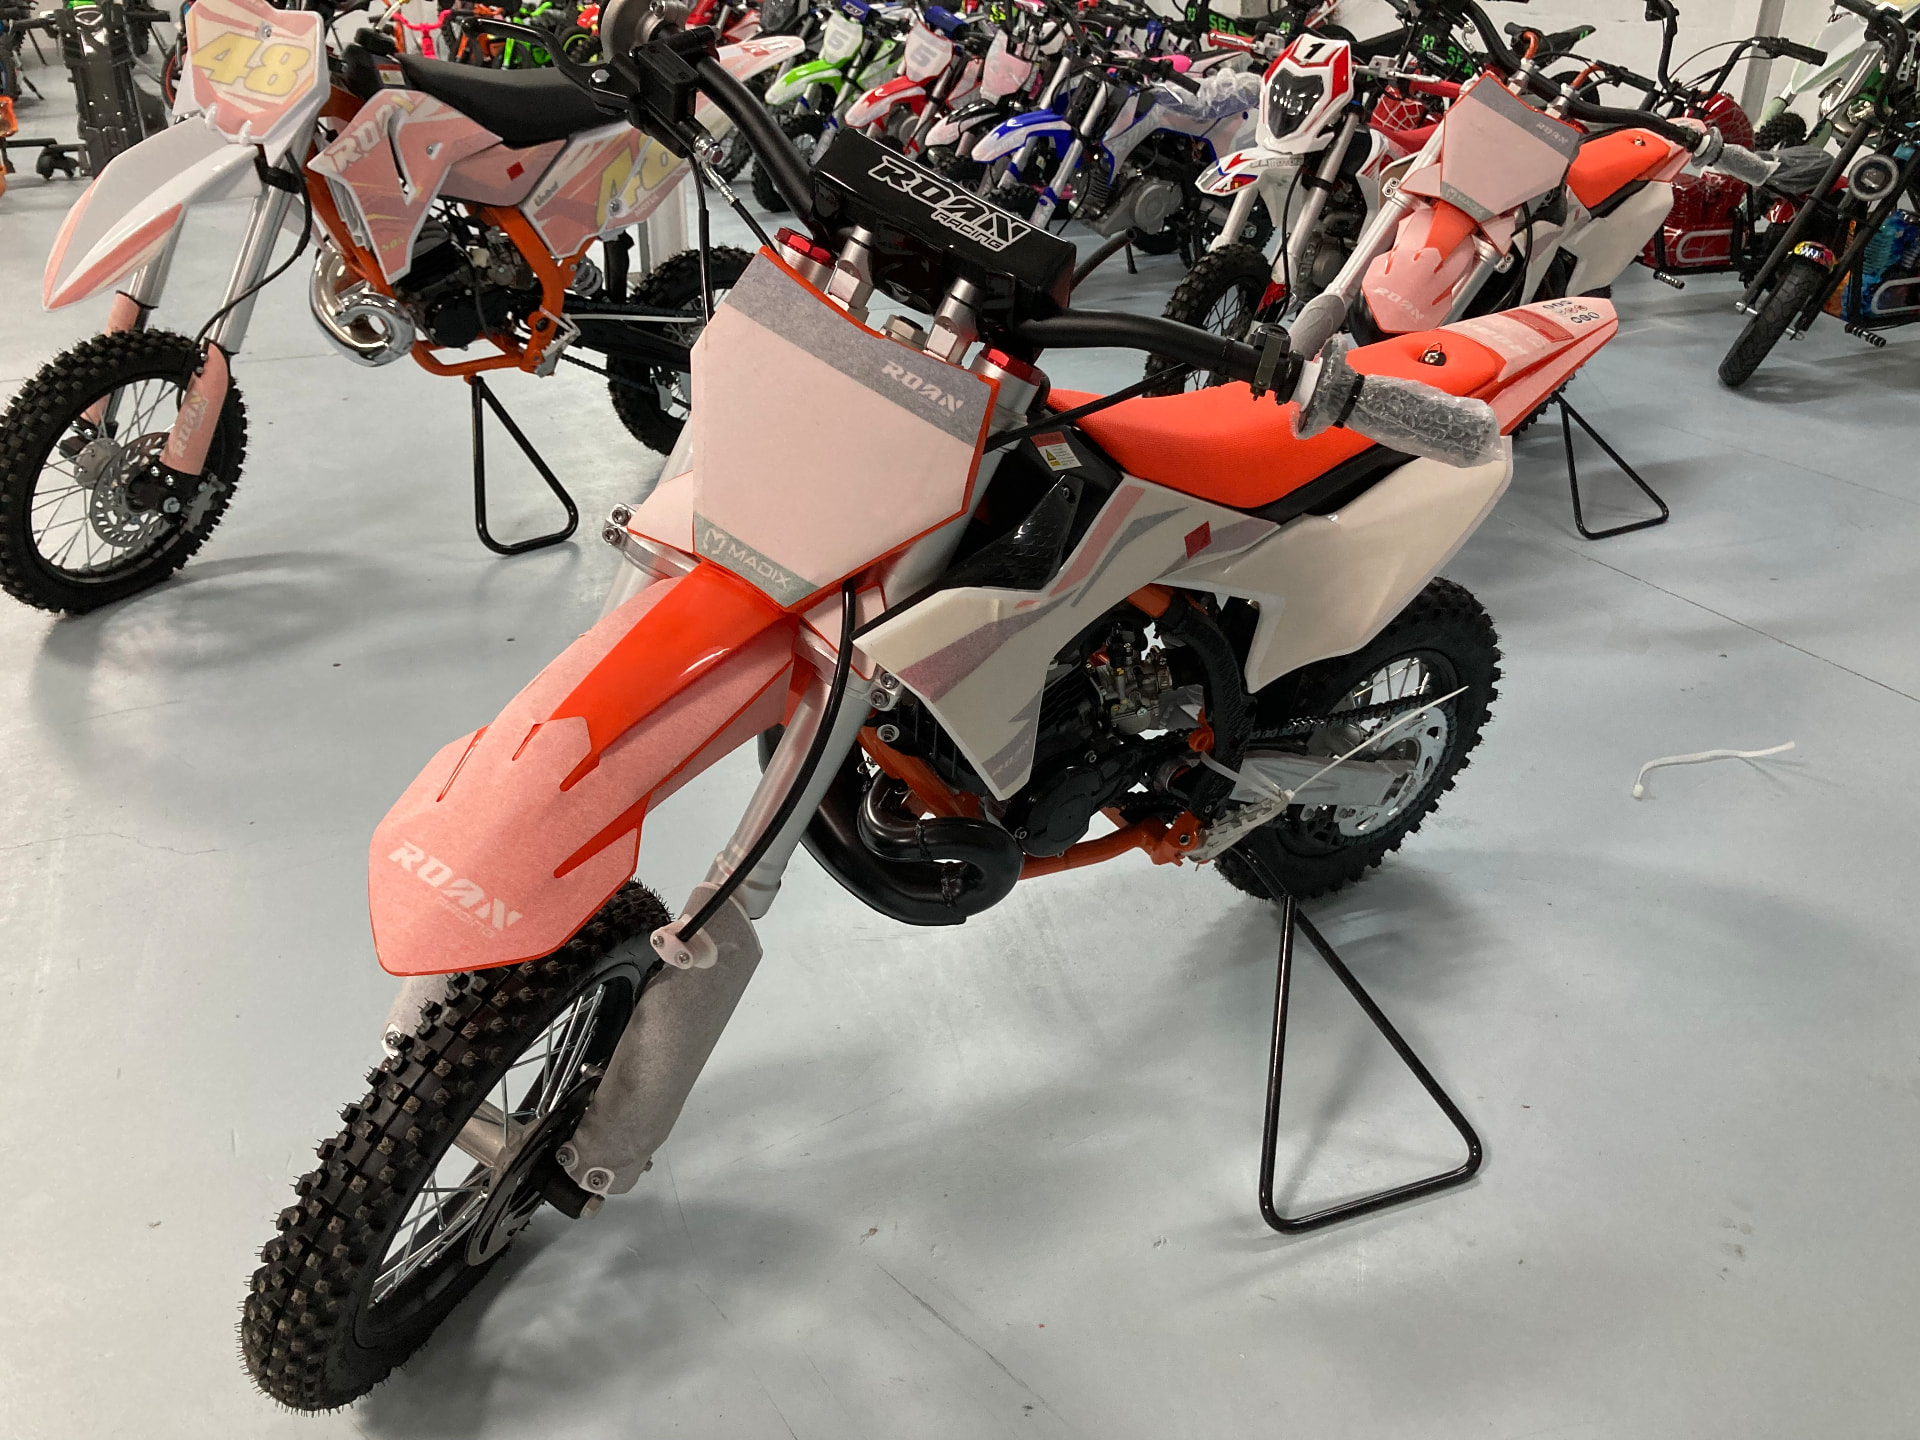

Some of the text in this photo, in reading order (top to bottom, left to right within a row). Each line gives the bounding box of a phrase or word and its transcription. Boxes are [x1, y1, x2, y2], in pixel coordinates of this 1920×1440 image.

[191, 31, 311, 97] 48
[1303, 42, 1327, 60] 1
[867, 154, 1031, 246] ROAN
[930, 209, 1008, 252] RACING
[881, 360, 965, 413] ROAN
[728, 543, 791, 591] MADIX
[387, 839, 523, 931] ROAN
